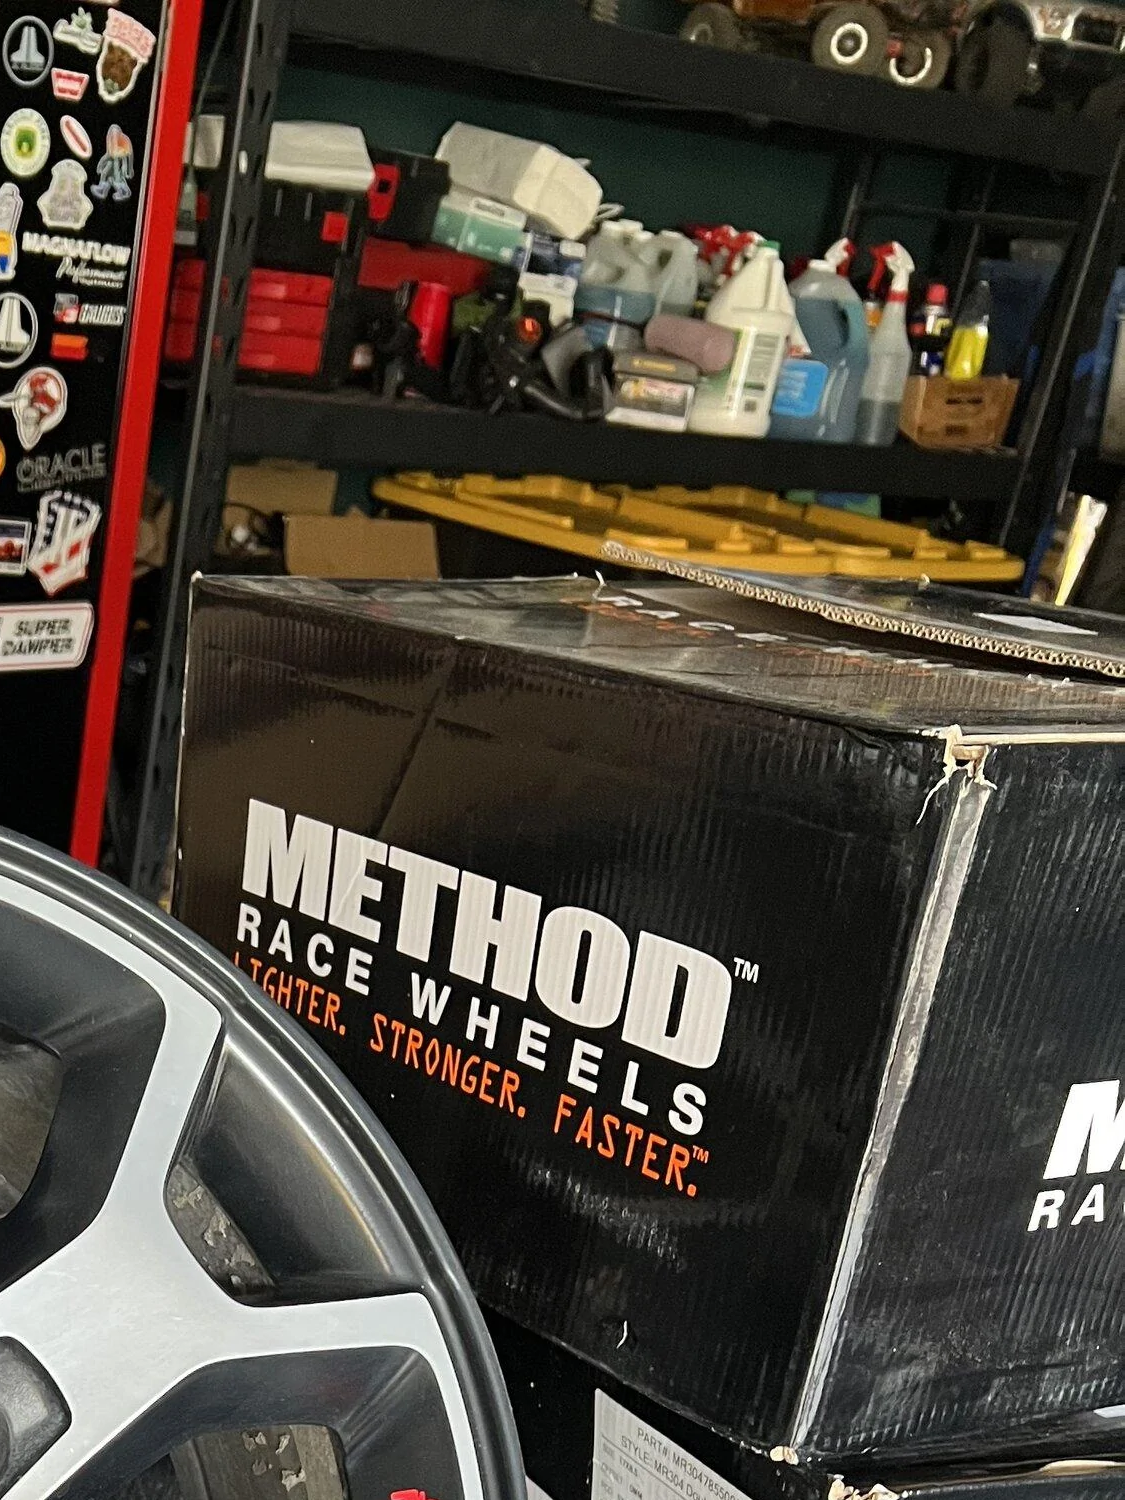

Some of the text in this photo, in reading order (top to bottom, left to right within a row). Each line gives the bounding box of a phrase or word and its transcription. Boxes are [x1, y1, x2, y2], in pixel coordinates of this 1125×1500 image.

[16, 442, 106, 484] ORACLE
[236, 902, 709, 1137] RACE WHEELS
[369, 1012, 527, 1118] STRONGER.
[653, 1459, 683, 1491] MR304
